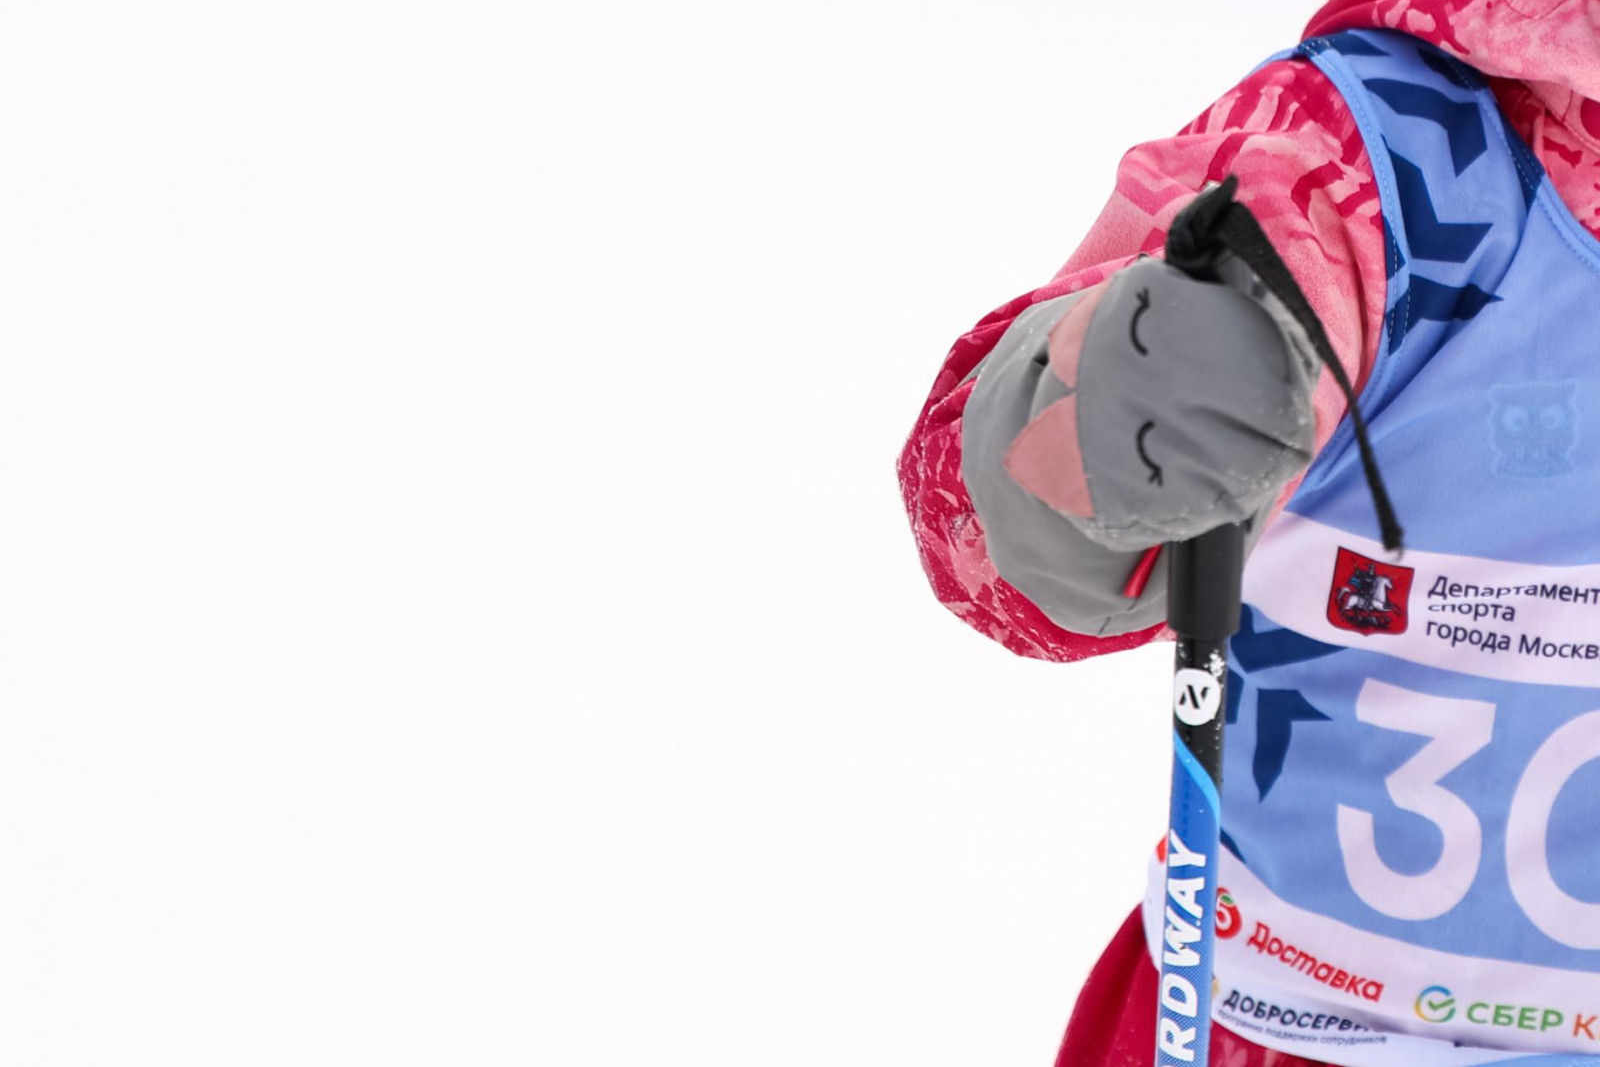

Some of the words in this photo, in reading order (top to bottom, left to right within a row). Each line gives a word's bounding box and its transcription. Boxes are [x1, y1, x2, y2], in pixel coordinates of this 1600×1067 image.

[1427, 602, 1516, 622] спорта
[1426, 620, 1511, 653] города
[1158, 828, 1207, 1067] RDWAY
[1247, 921, 1385, 1002] Доставка
[1222, 989, 1369, 1033] ДОБРОСЕРВ
[1466, 1001, 1565, 1032] СБЕР
